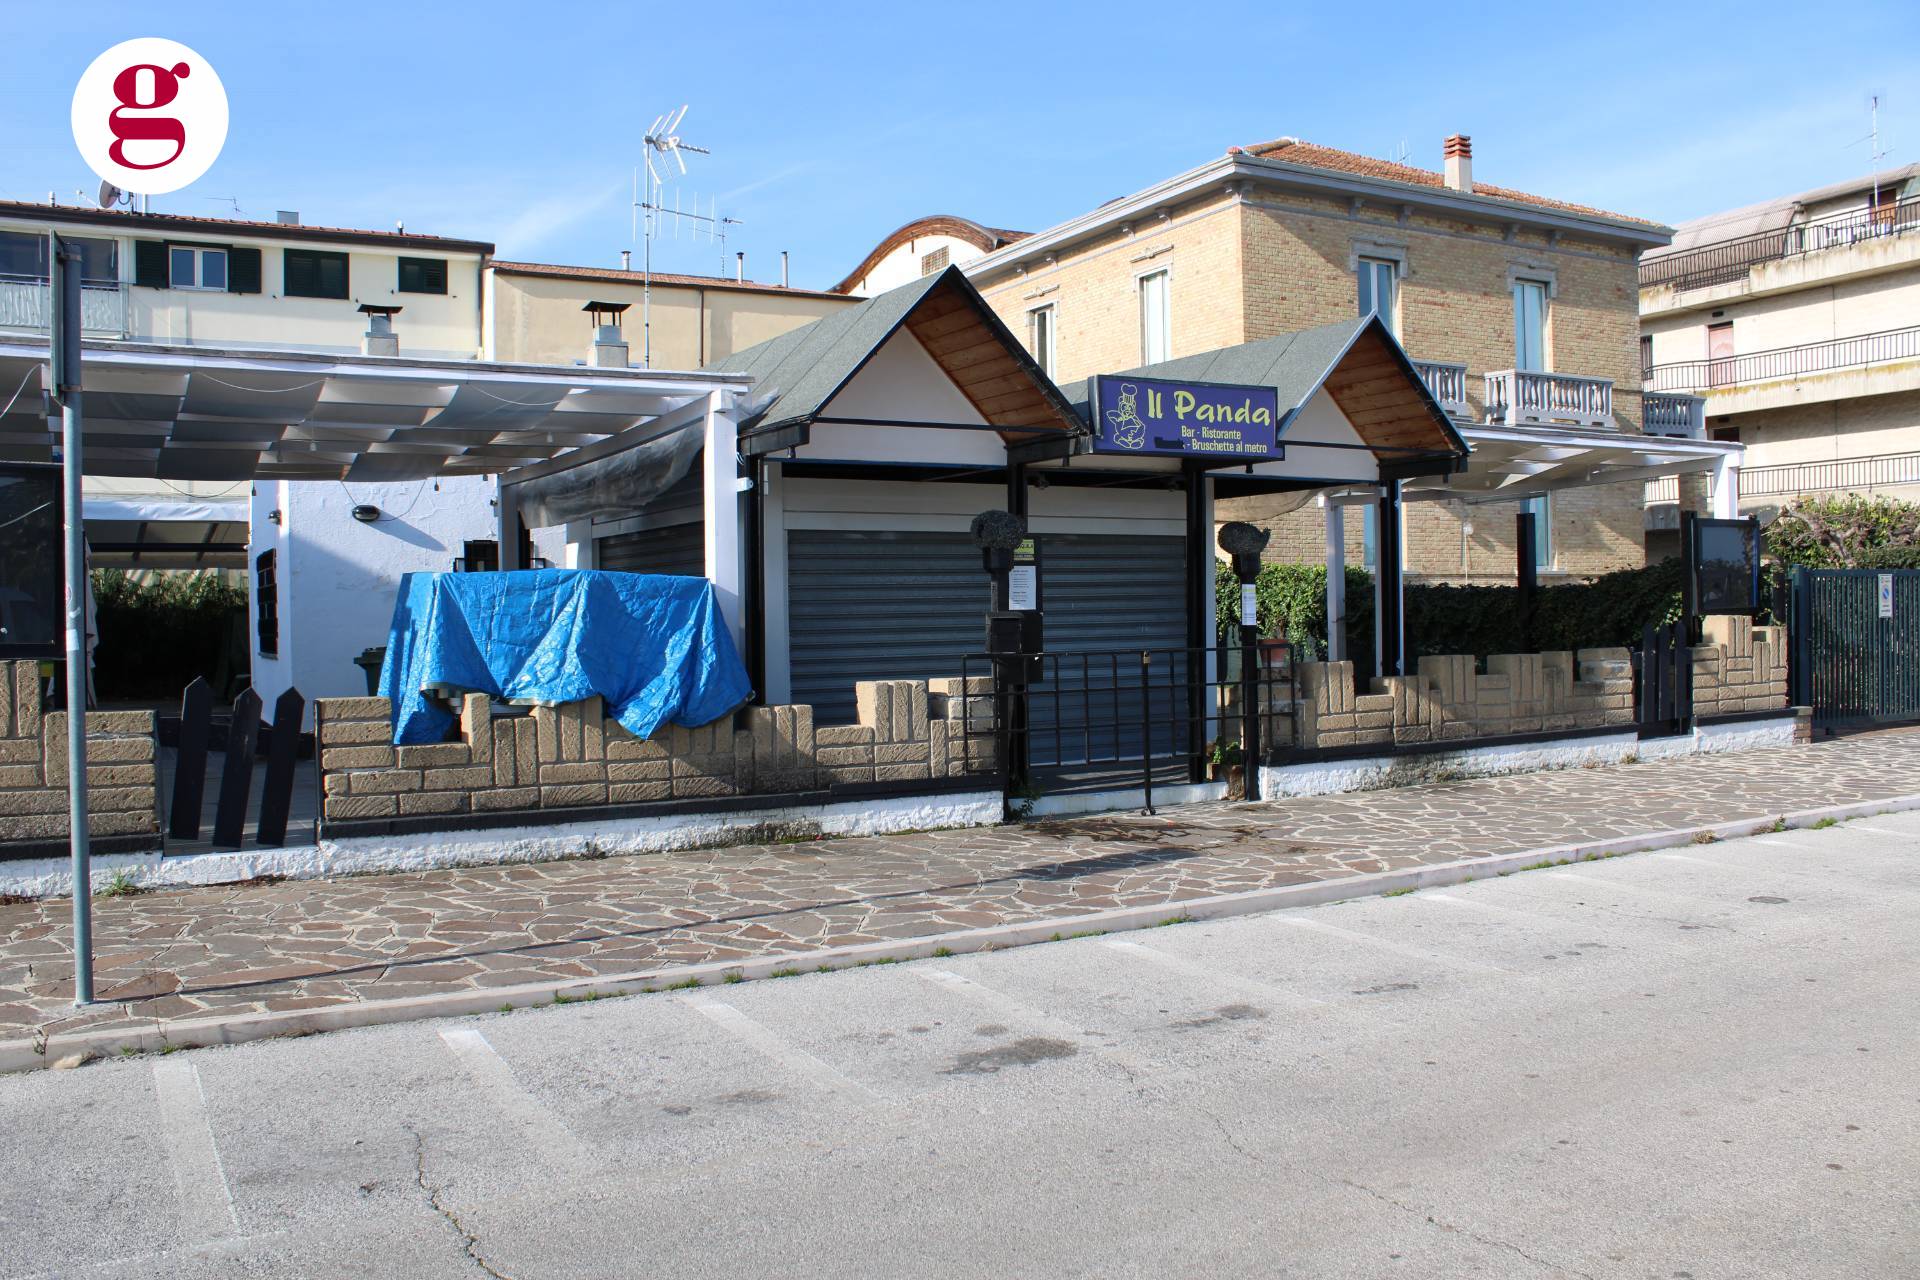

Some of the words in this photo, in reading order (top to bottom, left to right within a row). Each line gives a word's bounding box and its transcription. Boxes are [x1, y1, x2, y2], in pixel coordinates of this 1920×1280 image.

[1148, 388, 1162, 419] Il
[1174, 390, 1271, 426] Panda
[1181, 425, 1195, 437] Bar
[1202, 426, 1241, 440] Ristorante
[1192, 438, 1234, 452] Bruschette
[1235, 441, 1243, 452] al
[1244, 442, 1267, 453] metro
